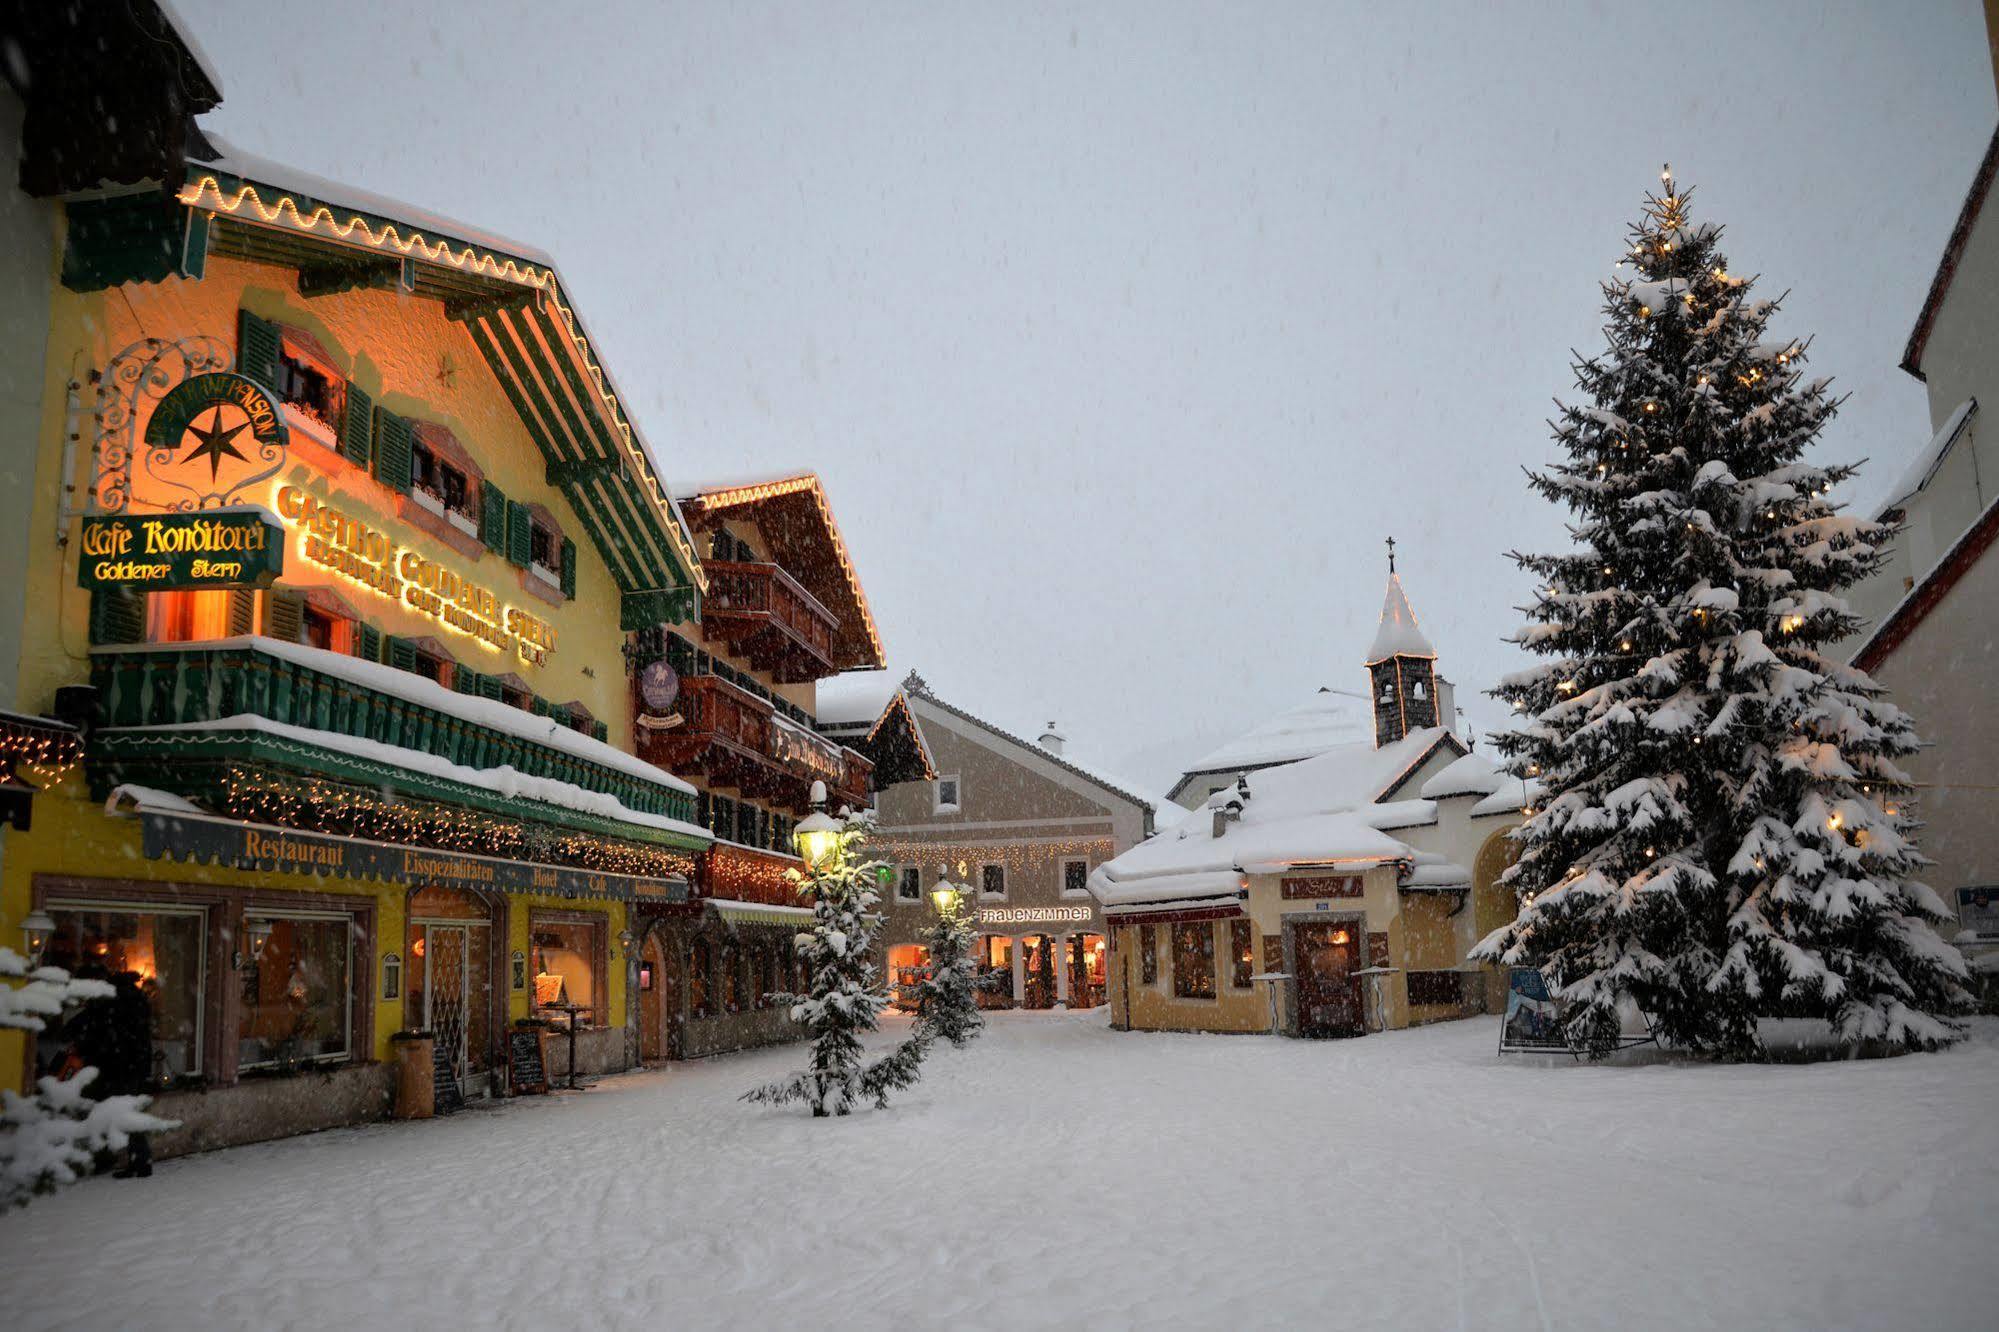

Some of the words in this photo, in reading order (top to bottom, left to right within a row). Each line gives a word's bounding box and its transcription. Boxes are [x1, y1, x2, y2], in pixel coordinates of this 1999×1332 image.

[226, 378, 277, 435] PENSION
[83, 522, 133, 557] Cafe
[142, 519, 265, 554] Konditorei
[95, 561, 171, 580] Goldener
[191, 559, 241, 579] Stern
[245, 830, 344, 866] Restaurant
[404, 851, 494, 882] Eisspezialitäten
[534, 867, 558, 888] Hotel
